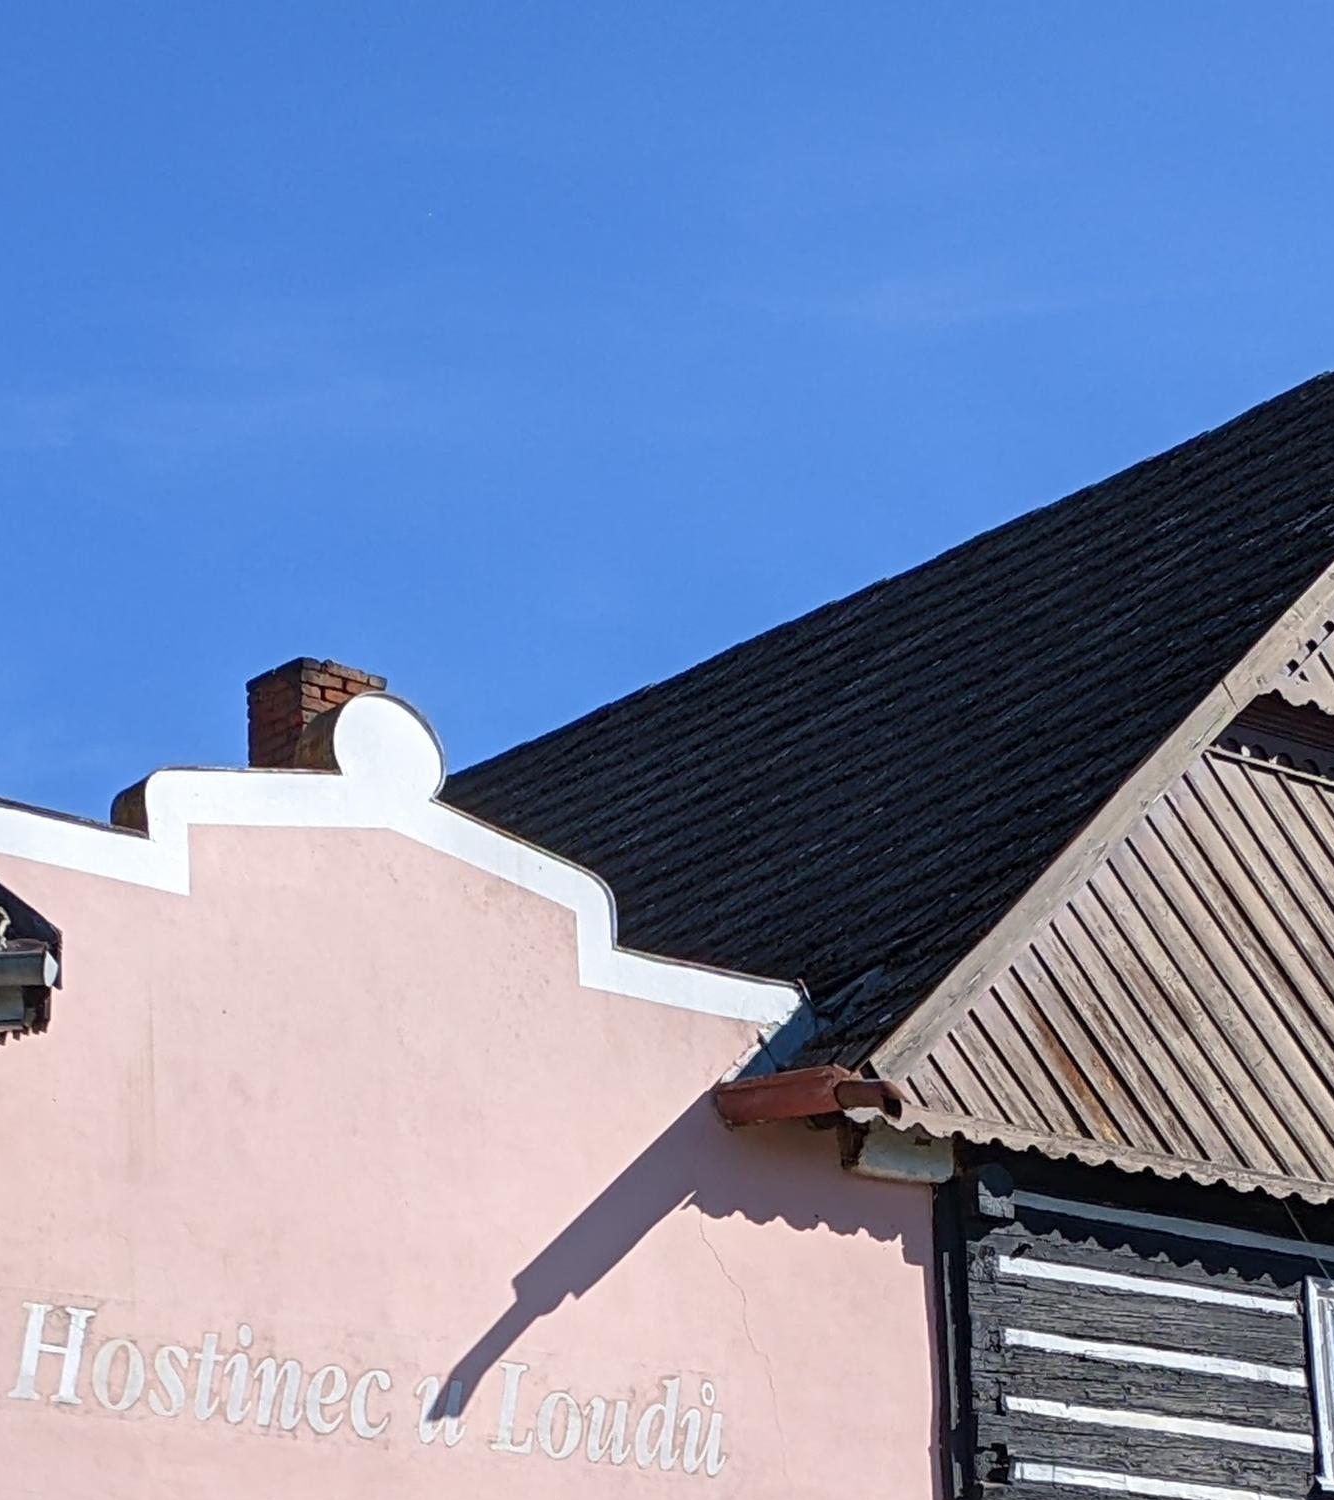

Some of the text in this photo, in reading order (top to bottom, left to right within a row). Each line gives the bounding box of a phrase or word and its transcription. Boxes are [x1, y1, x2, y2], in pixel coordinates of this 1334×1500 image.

[7, 1301, 729, 1477] Hostinec u Loudů
